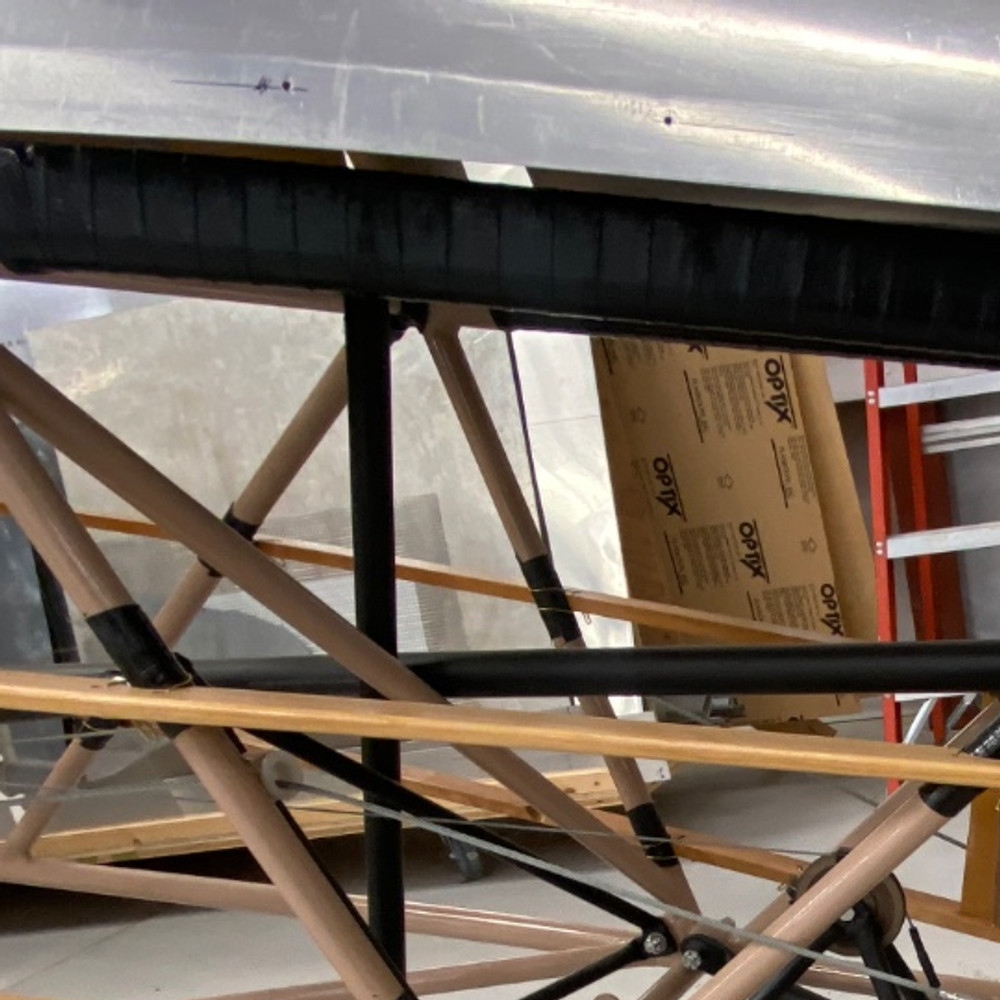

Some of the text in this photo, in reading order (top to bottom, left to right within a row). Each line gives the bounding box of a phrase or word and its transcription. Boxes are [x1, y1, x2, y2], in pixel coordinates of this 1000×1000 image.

[764, 358, 792, 424] OPTIX
[653, 456, 682, 516] OPTIX
[740, 522, 767, 579] OPTIX
[820, 583, 844, 637] OPTIX
